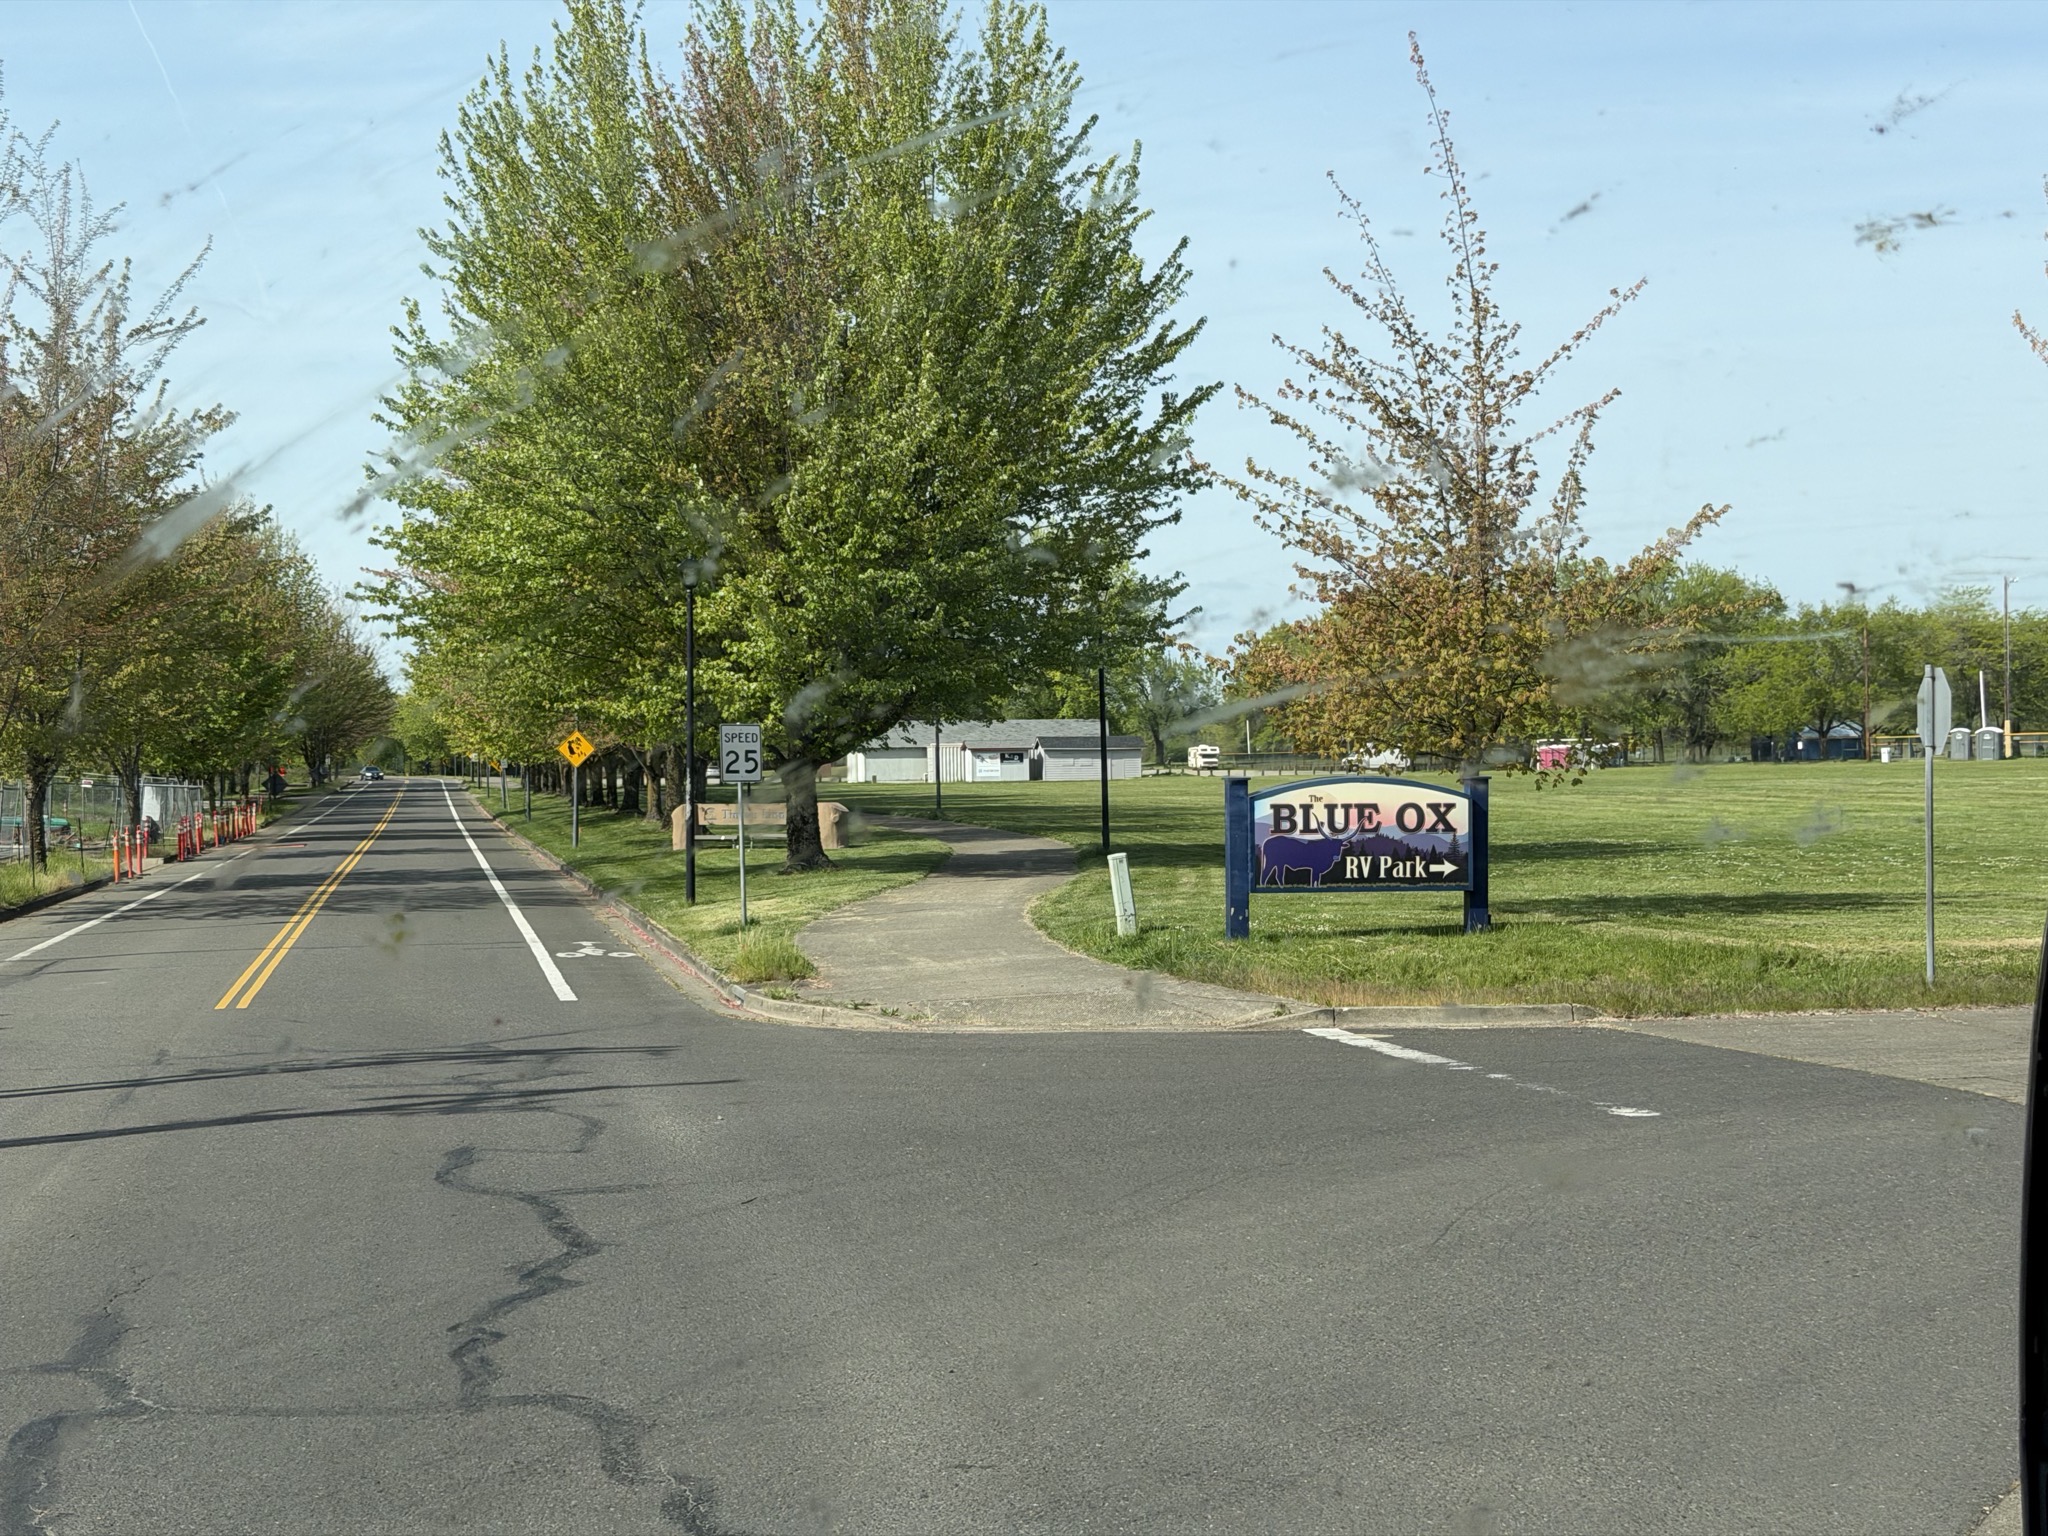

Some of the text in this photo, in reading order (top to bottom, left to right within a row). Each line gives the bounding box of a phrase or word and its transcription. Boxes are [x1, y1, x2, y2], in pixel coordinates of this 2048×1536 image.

[724, 732, 758, 743] SPEED
[725, 750, 758, 774] 25
[1308, 794, 1324, 803] The
[1269, 802, 1457, 835] BLUE OX
[1344, 855, 1428, 879] RV Park
